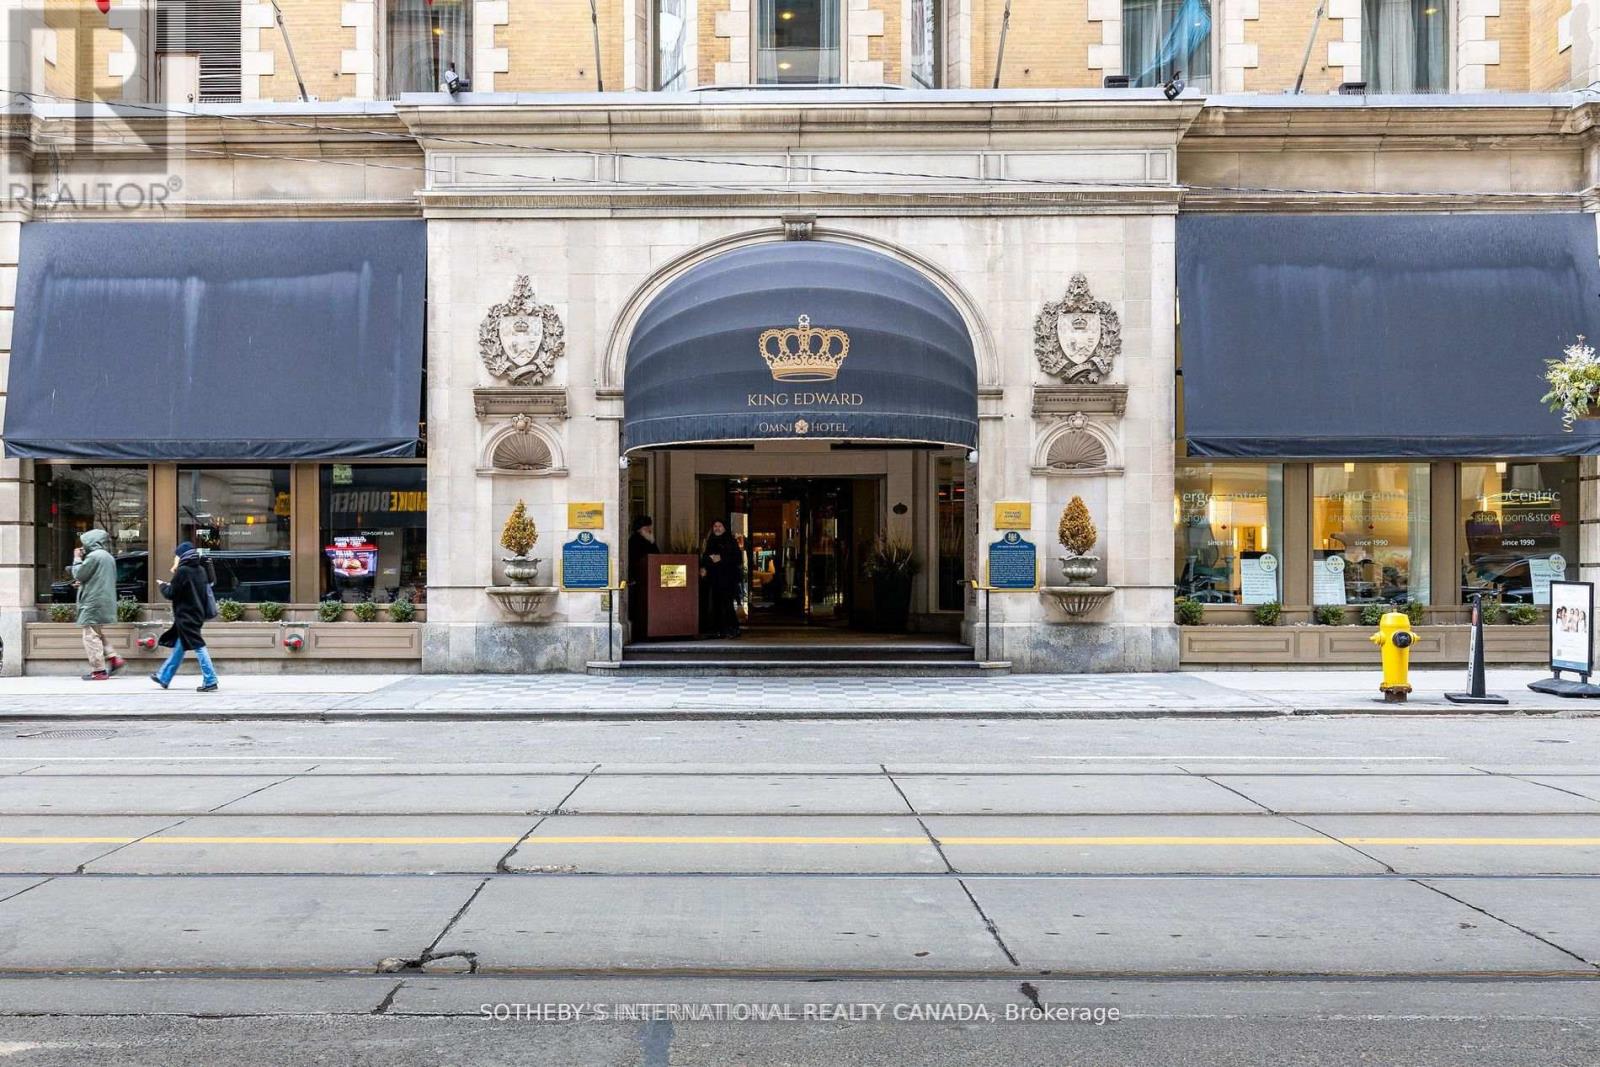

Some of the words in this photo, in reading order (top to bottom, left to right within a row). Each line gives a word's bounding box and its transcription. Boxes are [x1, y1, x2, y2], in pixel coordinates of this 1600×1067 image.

[747, 393, 789, 406] KING
[794, 392, 863, 406] EDWARD
[811, 422, 848, 432] HOTEL
[1182, 489, 1267, 507] ergoentric
